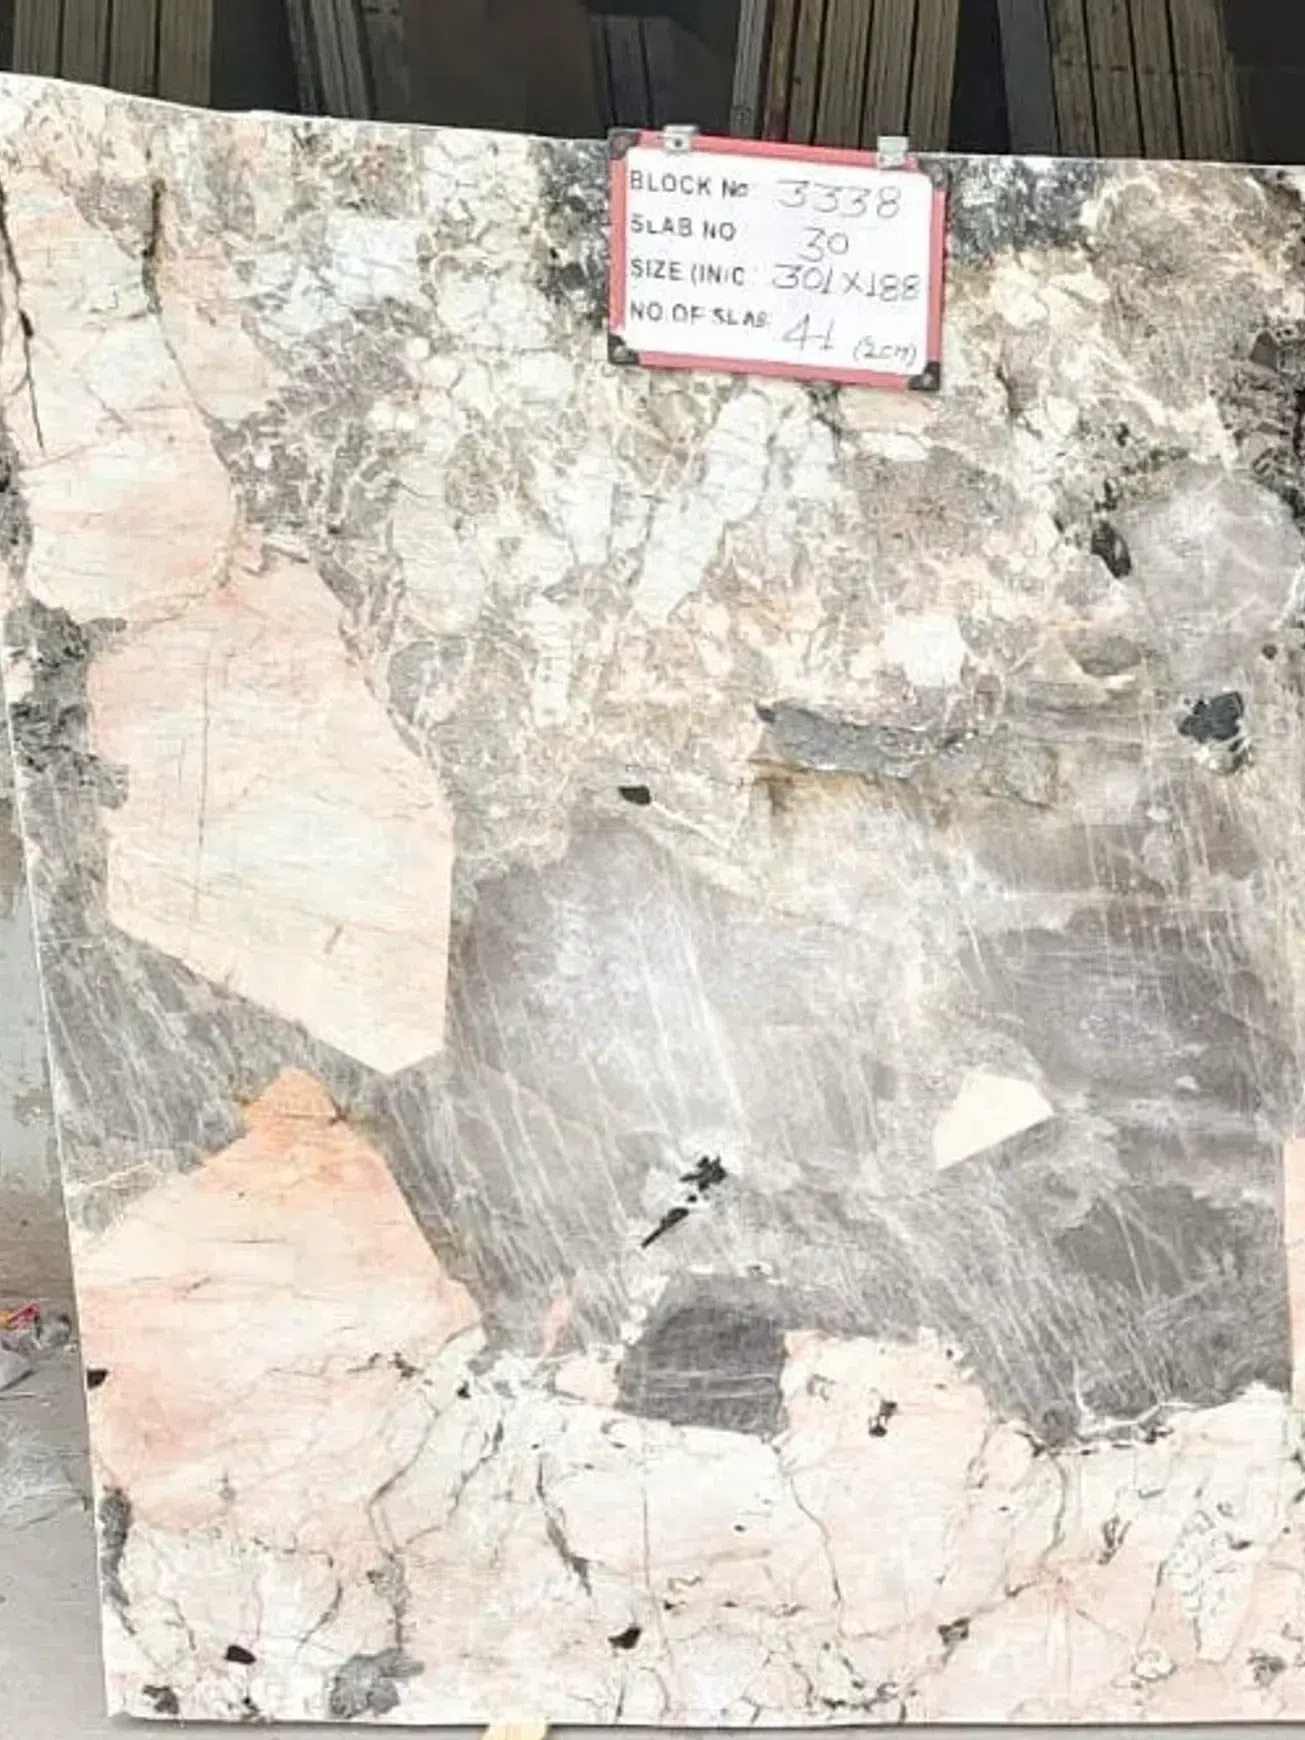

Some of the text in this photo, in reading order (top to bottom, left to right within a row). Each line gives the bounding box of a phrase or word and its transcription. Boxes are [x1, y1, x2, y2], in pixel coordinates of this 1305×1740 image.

[630, 169, 711, 196] BLOCK
[775, 178, 901, 219] 3338
[630, 212, 693, 238] SLAB
[797, 225, 850, 263] 30
[630, 257, 683, 282] SIZE
[671, 303, 706, 325] OF
